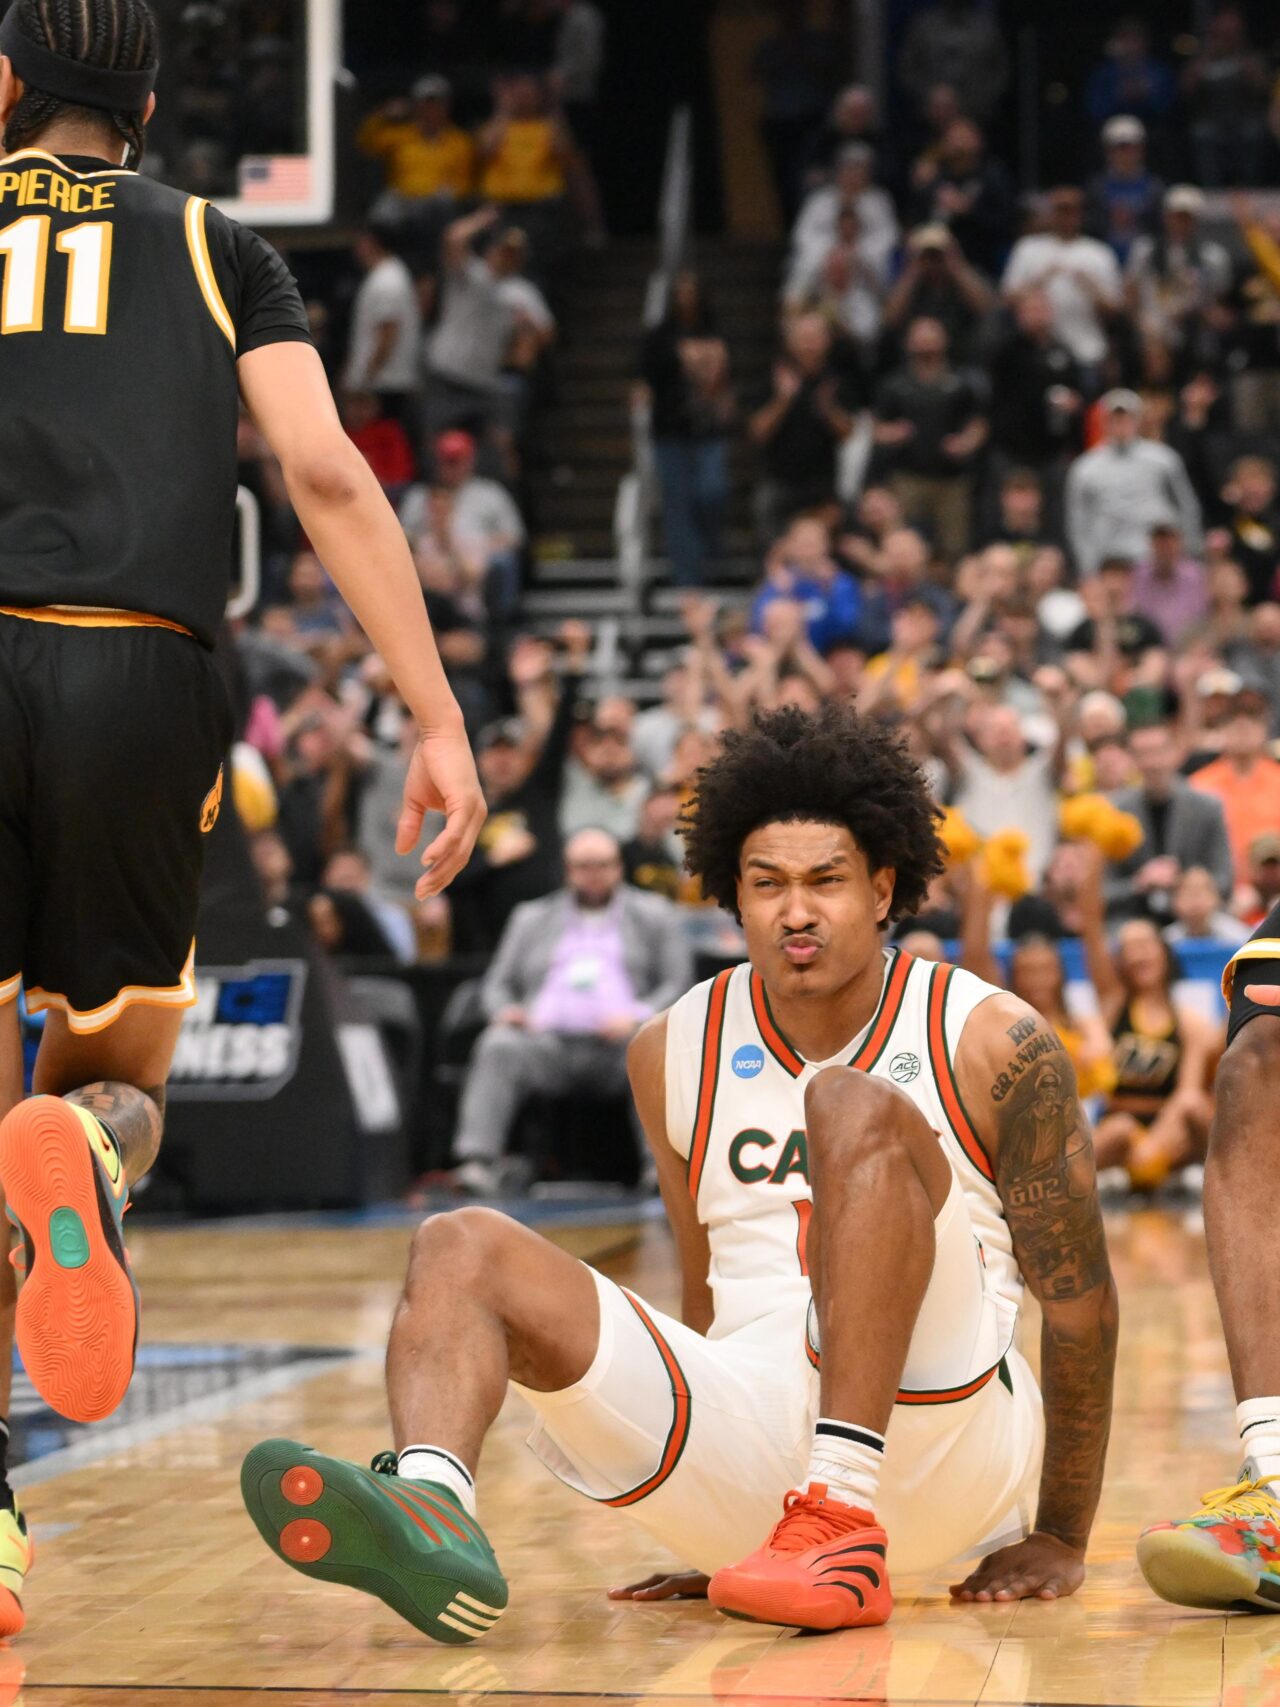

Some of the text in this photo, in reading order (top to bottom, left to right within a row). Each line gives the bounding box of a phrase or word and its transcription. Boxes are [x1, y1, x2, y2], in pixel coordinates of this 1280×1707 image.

[0, 169, 116, 213] PIERCE
[0, 215, 113, 335] 11
[735, 1060, 762, 1070] NCAA
[894, 1061, 918, 1070] ACC
